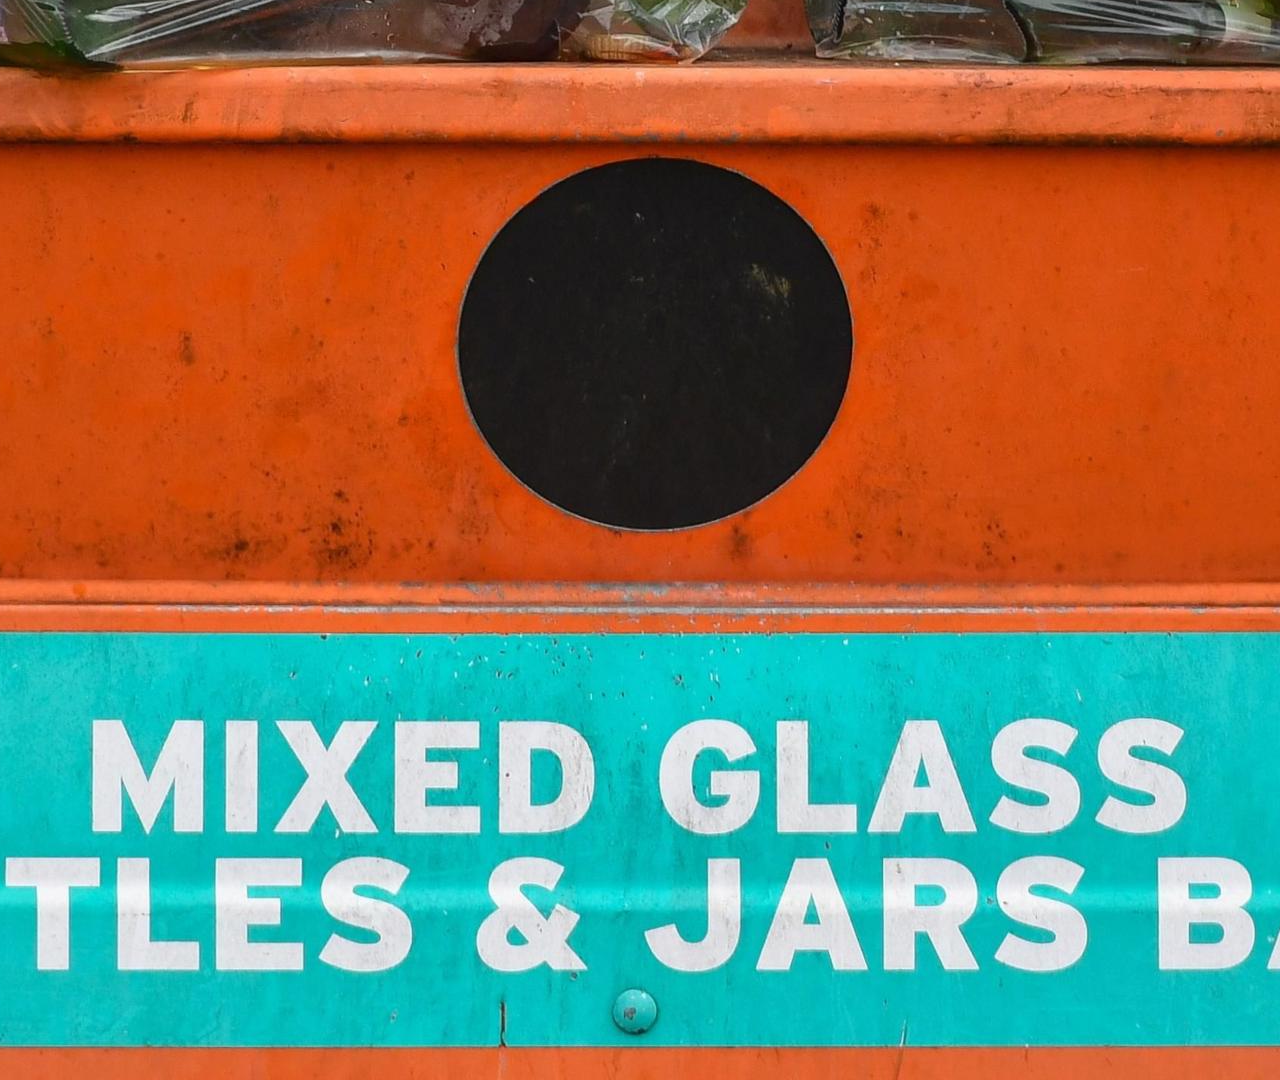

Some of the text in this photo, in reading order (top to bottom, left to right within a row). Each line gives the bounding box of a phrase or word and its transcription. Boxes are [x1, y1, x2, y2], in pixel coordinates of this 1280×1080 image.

[91, 719, 1188, 835] MIXED GLASS
[476, 856, 589, 973] &
[644, 856, 1089, 973] JARS
